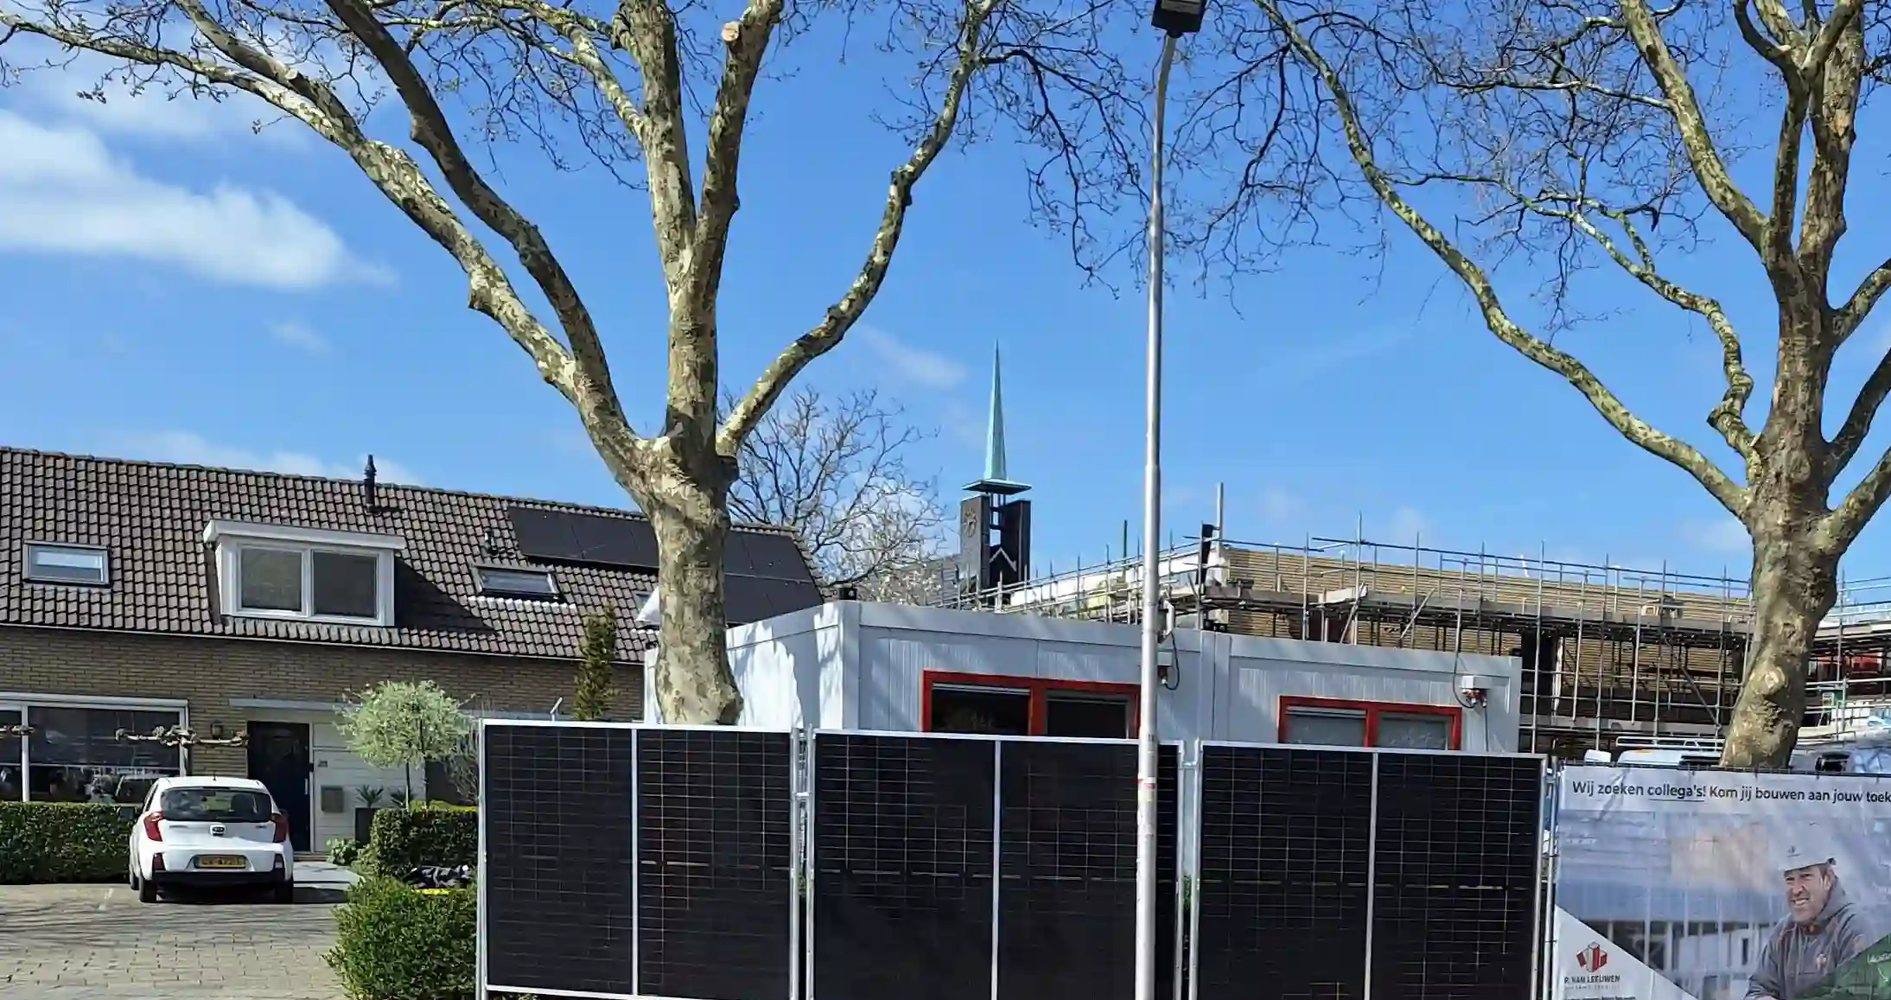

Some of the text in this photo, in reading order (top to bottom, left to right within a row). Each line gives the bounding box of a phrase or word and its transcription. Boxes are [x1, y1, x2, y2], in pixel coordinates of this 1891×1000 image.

[1572, 780, 1594, 796] Wij
[1598, 782, 1644, 796] zoeken
[1647, 783, 1706, 799] collega's!
[1709, 786, 1738, 798] Kom
[1740, 786, 1752, 801] jij
[1755, 786, 1805, 801] bouwen
[1808, 791, 1830, 801] aan
[1831, 789, 1863, 804] jouw
